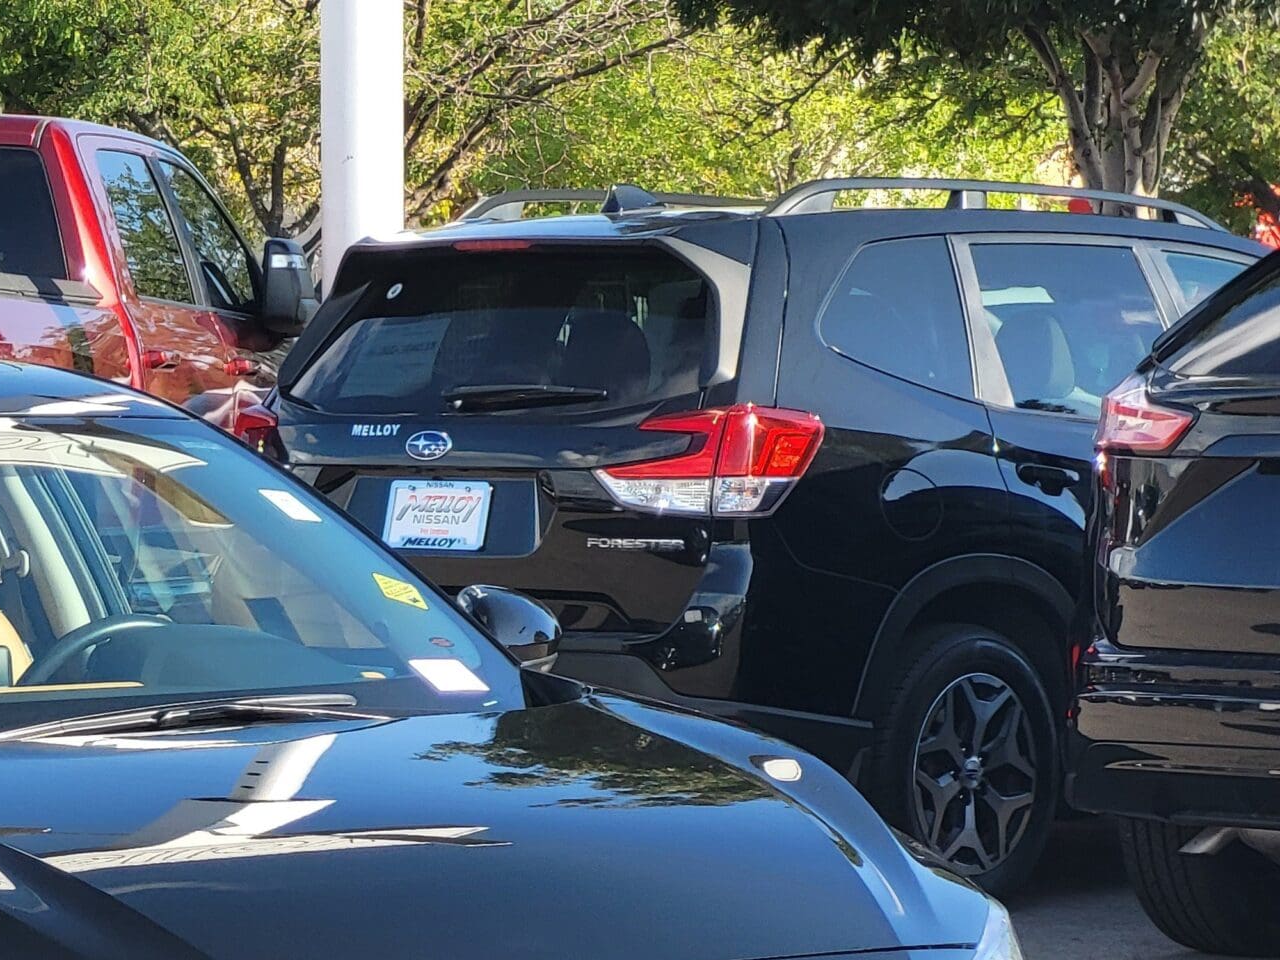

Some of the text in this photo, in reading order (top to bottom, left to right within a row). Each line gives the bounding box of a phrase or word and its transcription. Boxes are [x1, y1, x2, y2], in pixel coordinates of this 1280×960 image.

[351, 424, 401, 436] MELLOY
[412, 514, 461, 525] NISSAN
[402, 537, 458, 548] MELLOY
[587, 538, 685, 550] FORESTER
